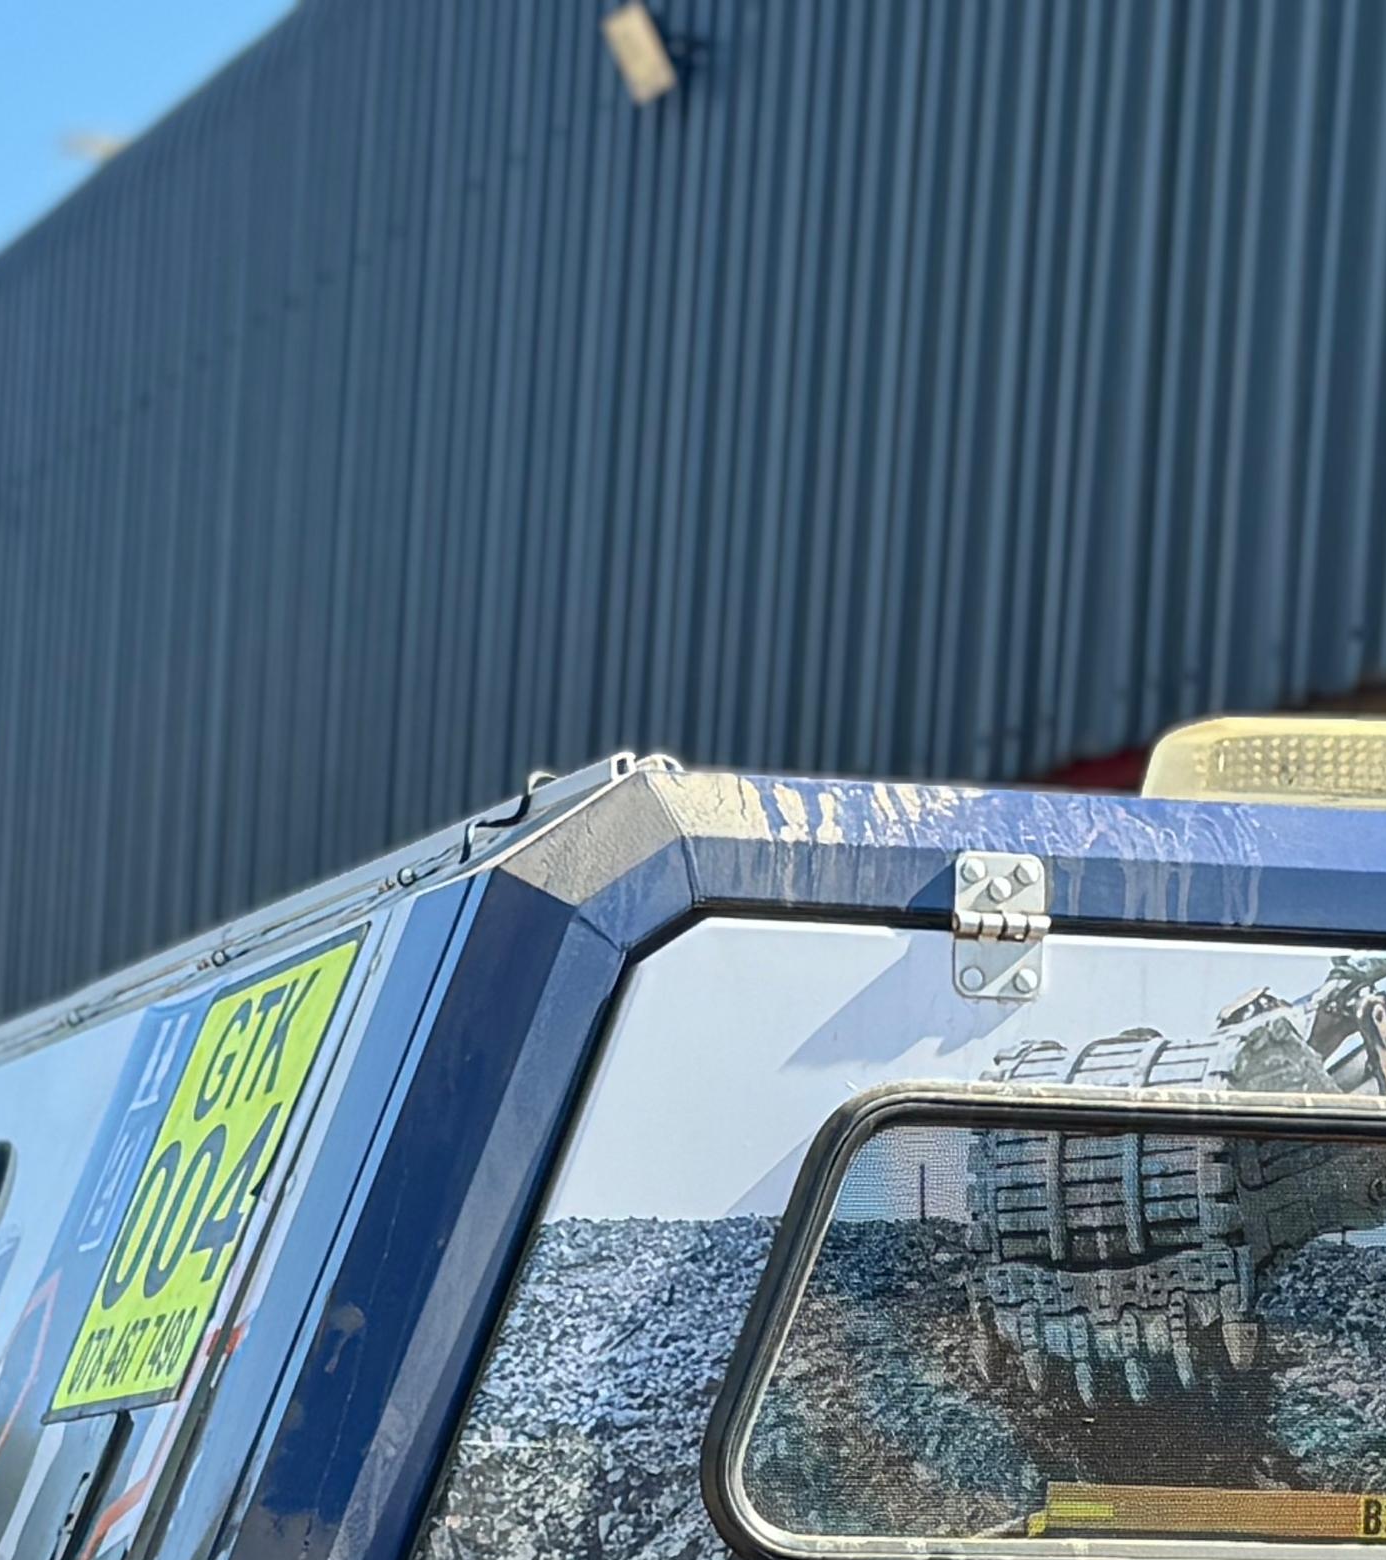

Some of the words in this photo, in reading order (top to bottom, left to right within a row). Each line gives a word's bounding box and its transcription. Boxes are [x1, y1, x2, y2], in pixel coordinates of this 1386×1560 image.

[194, 968, 322, 1122] GTK
[102, 1102, 283, 1309] 004
[133, 1306, 198, 1381] 7498
